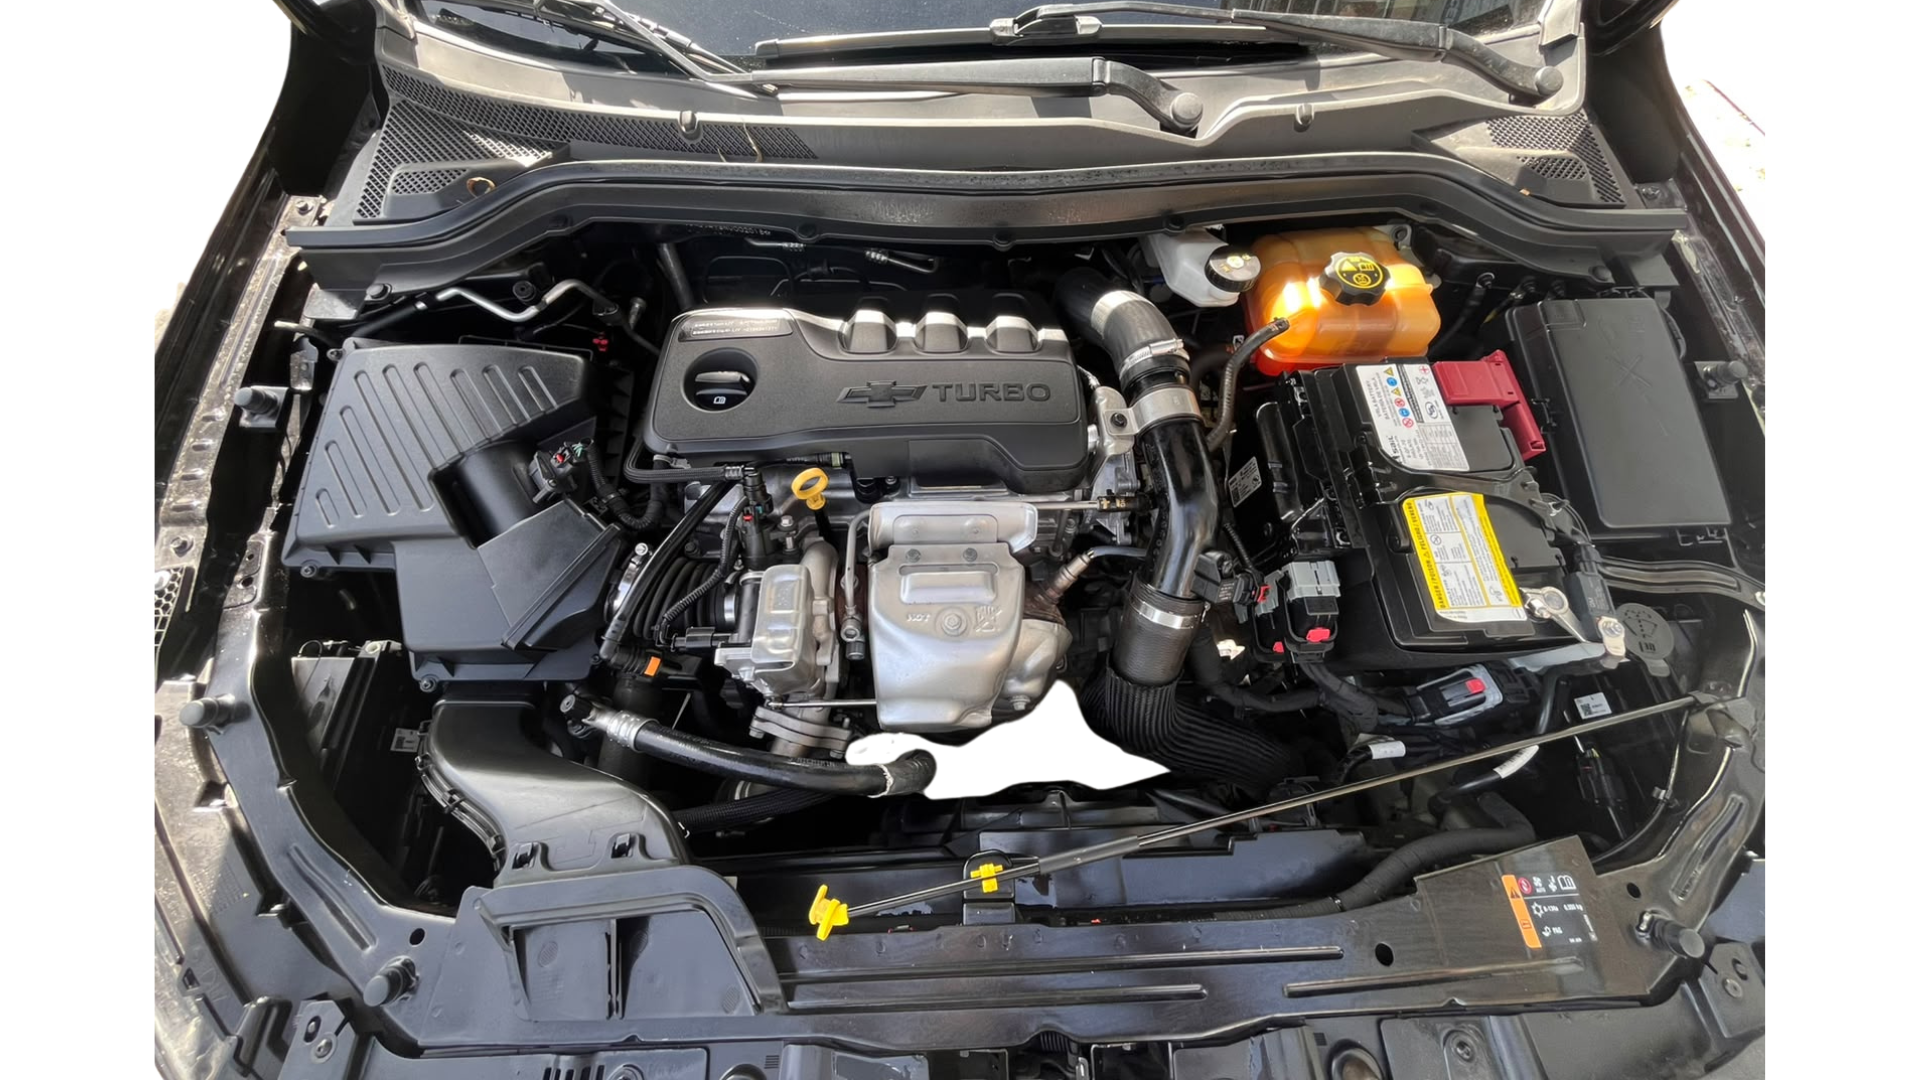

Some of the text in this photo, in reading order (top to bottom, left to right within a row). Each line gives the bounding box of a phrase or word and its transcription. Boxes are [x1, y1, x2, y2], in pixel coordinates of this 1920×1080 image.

[932, 383, 1051, 402] TURBO
[1365, 379, 1377, 402] BATTERY
[1406, 501, 1417, 522] VENENO
[1413, 526, 1426, 550] PELIGRO
[1424, 559, 1436, 577] POISON
[1433, 583, 1446, 608] DANGER
